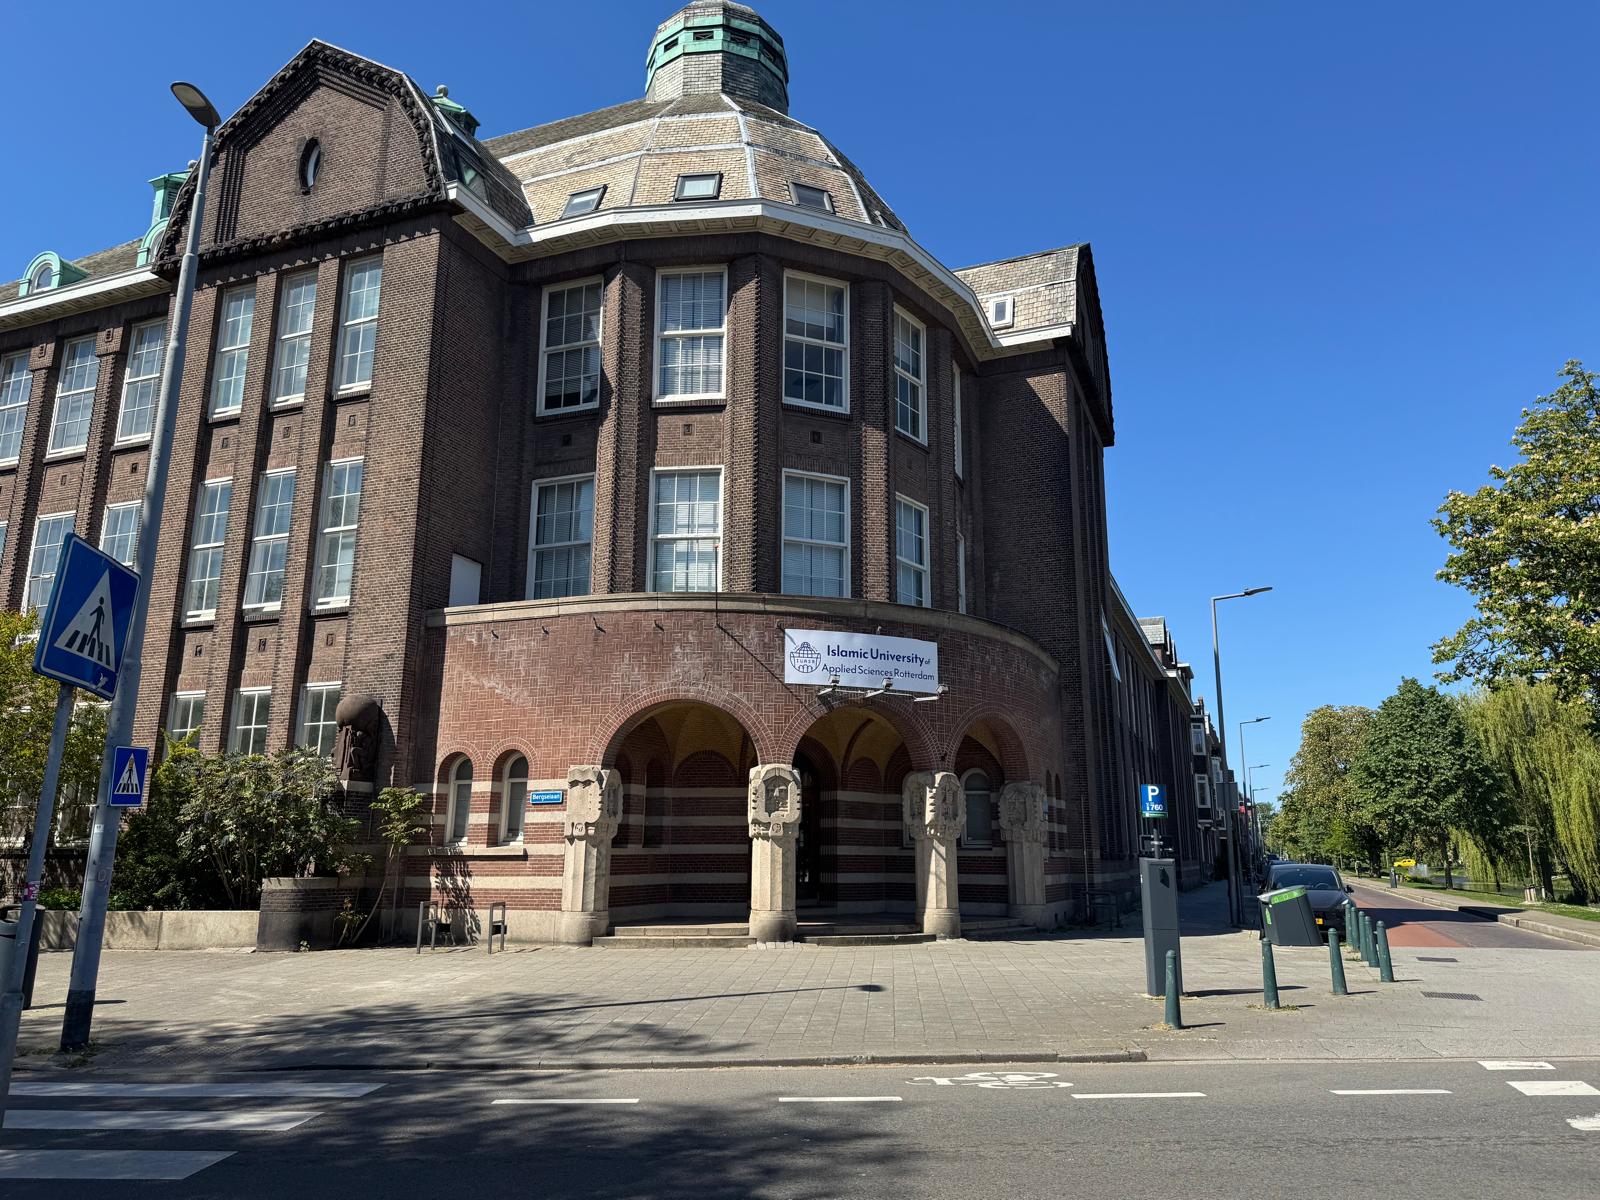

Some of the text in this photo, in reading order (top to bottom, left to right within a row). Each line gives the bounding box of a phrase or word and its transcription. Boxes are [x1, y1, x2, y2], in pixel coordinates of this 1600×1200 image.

[827, 645, 869, 660] Islamic
[870, 648, 924, 667] University
[822, 664, 935, 681] Applied Sciences Rotterdam
[1148, 786, 1159, 801] P
